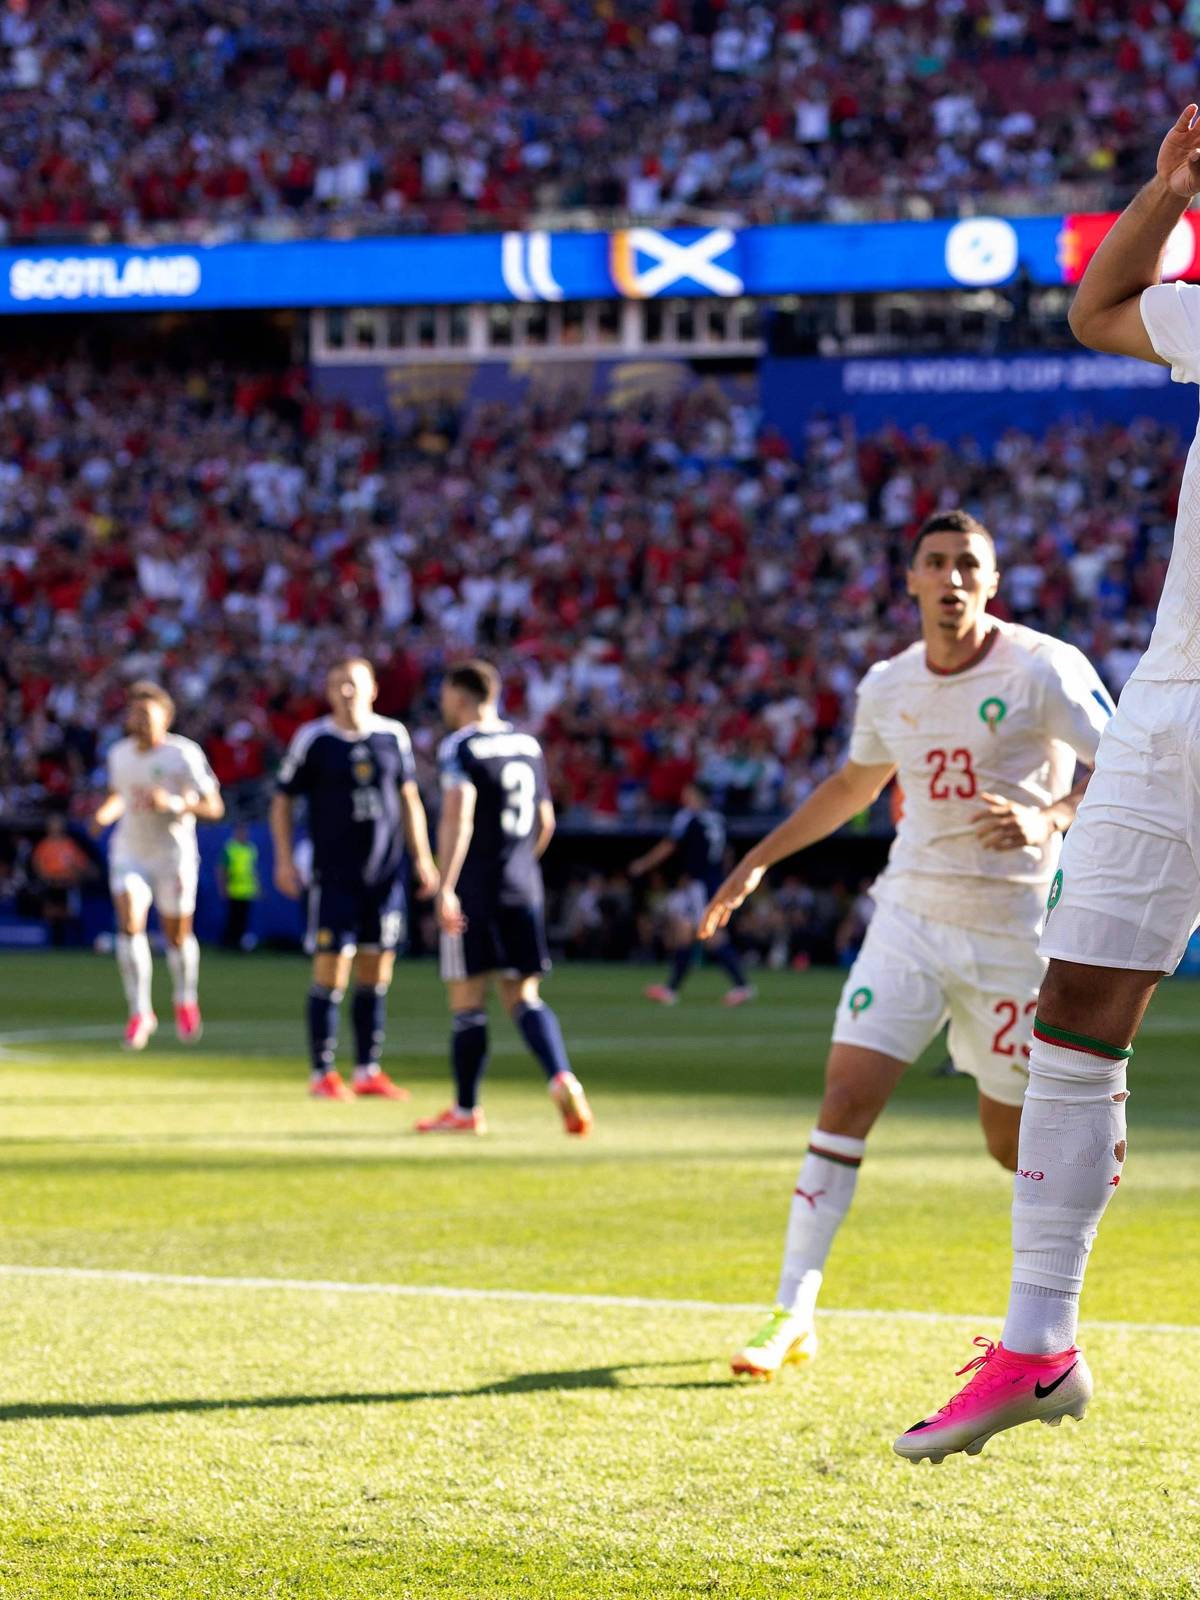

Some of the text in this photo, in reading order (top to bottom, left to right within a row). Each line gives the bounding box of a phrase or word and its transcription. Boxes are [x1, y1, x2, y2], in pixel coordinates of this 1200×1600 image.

[10, 256, 200, 299] SCOTLAND
[906, 359, 1005, 391] WORLD
[1010, 358, 1064, 390] CUP
[926, 748, 977, 800] 23
[501, 761, 535, 837] 3
